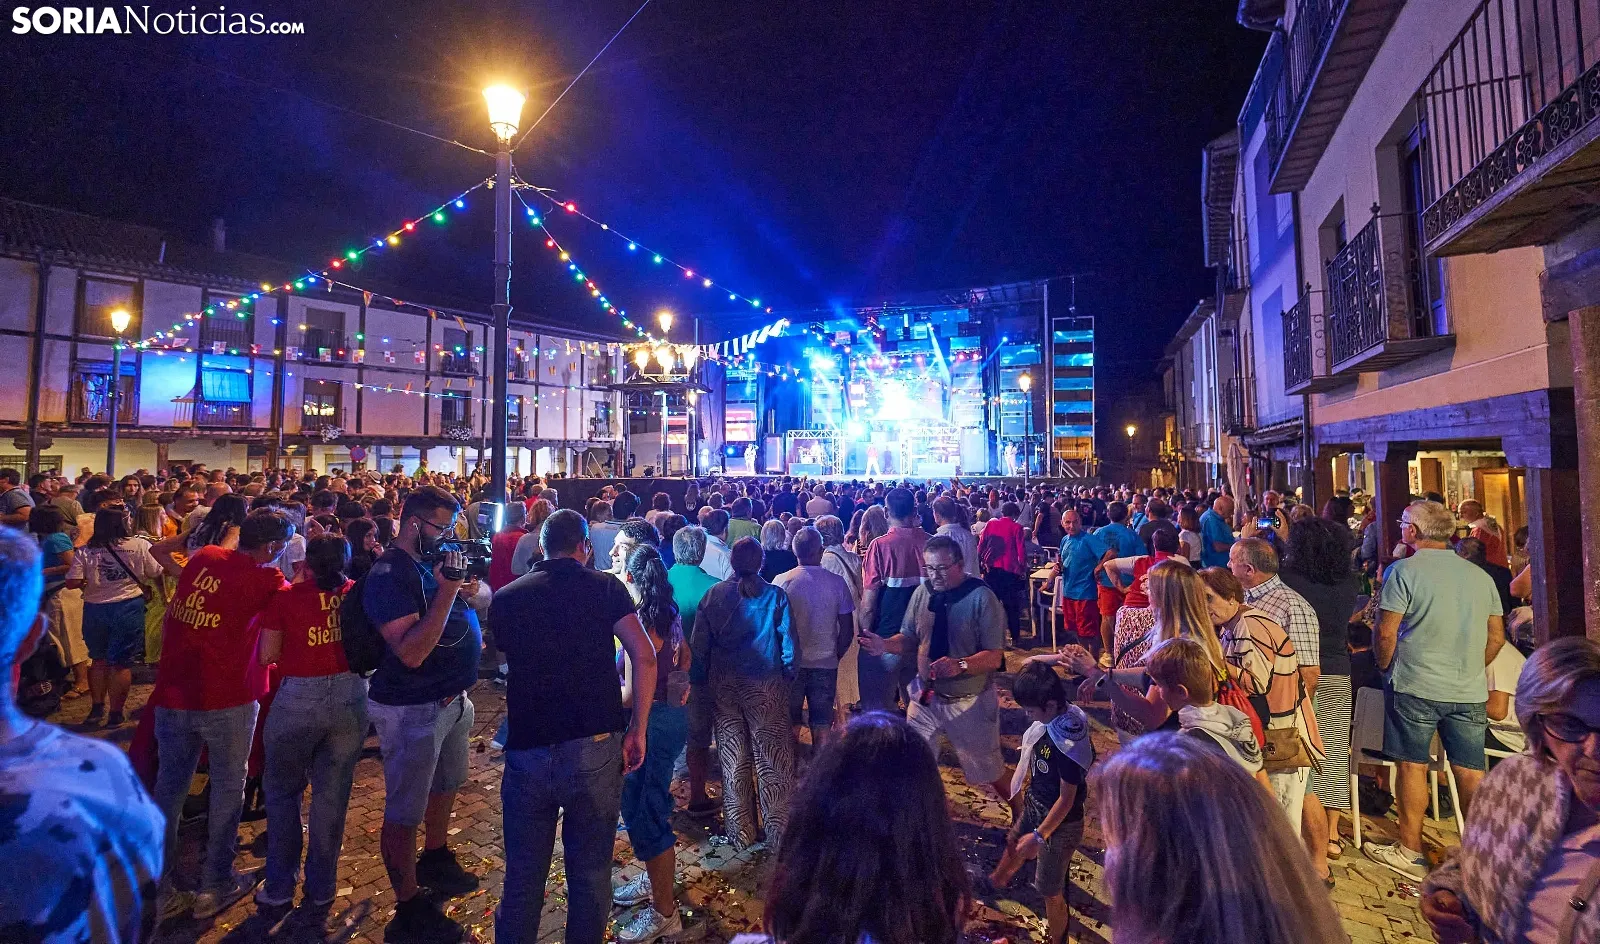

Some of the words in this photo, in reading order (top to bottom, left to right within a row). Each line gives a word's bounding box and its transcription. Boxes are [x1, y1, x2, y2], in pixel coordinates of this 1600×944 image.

[193, 567, 221, 593] Los
[185, 590, 205, 610] de
[171, 599, 221, 630] Siempre
[327, 610, 341, 629] d
[308, 626, 342, 646] Siem
